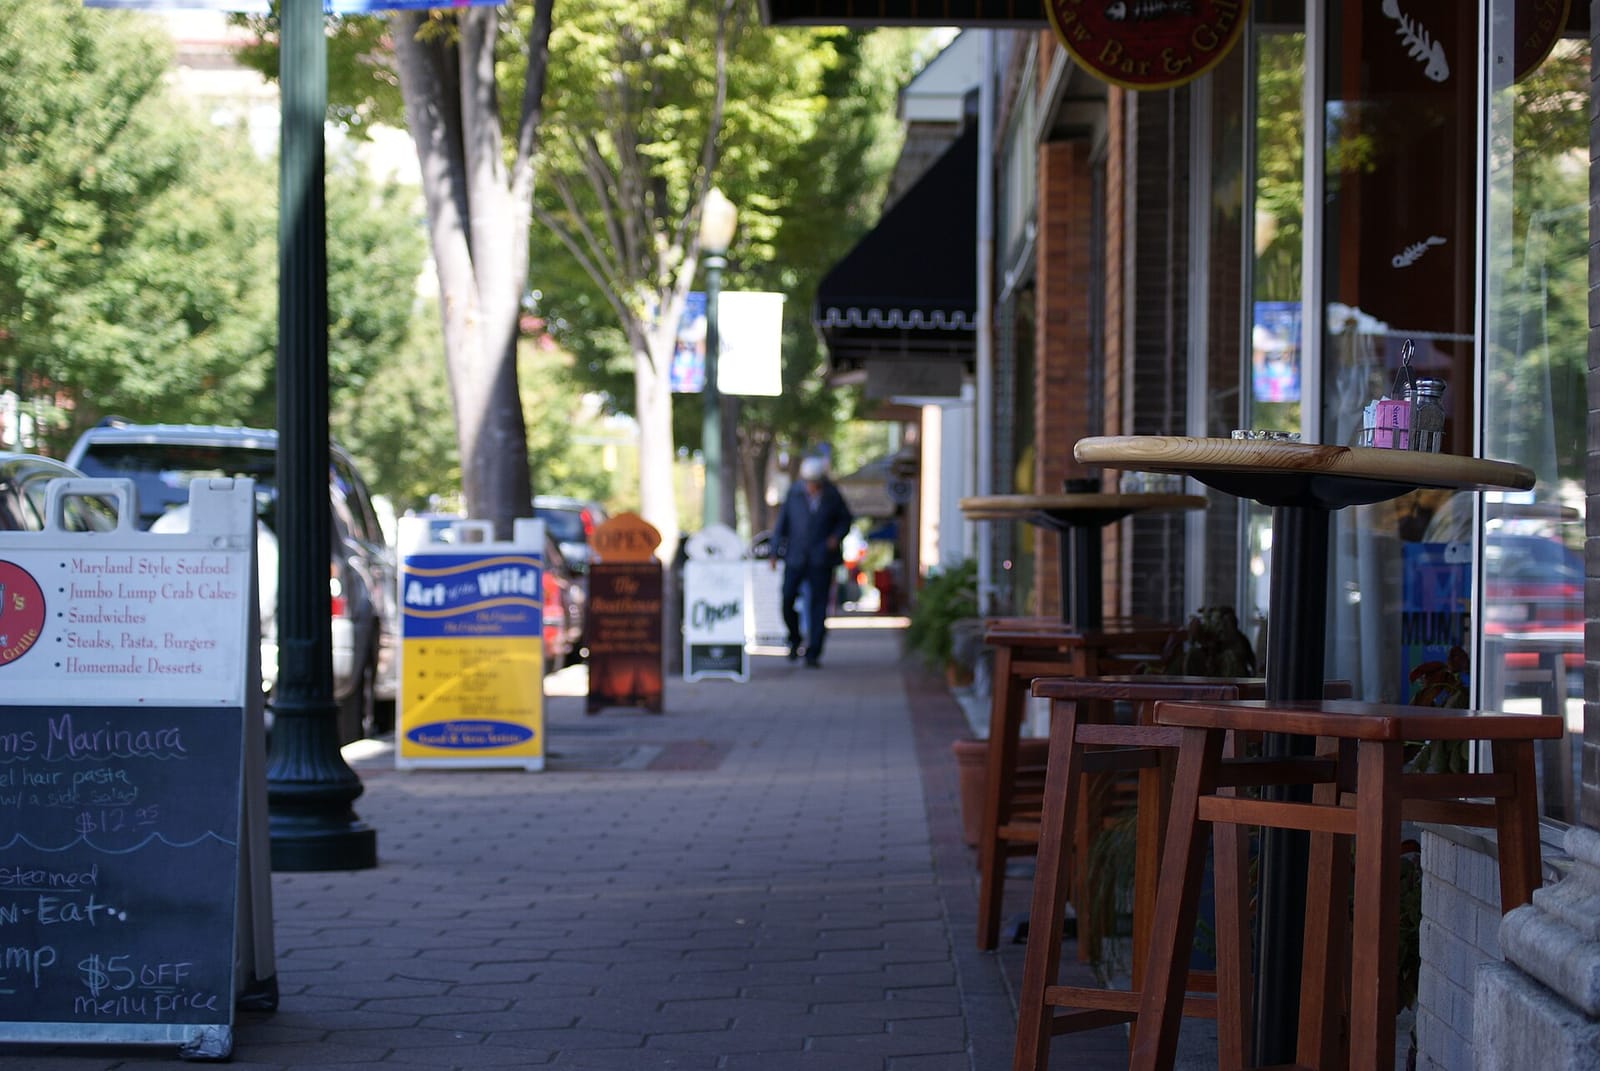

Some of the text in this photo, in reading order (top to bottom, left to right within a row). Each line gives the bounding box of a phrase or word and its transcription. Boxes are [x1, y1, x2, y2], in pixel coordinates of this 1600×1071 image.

[1056, 0, 1091, 41] aw
[1099, 39, 1150, 75] Bar
[1160, 47, 1192, 74] &
[71, 556, 230, 578] Maryland Style Seafood
[69, 581, 237, 604] Jumbo Lump Crab Cakes
[405, 580, 445, 606] Art
[478, 567, 537, 597] Wild
[68, 605, 147, 624] Sandwiches
[691, 600, 740, 634] Open
[2, 628, 37, 660] Grille
[66, 630, 217, 651] Steaks, Pasta, Burgers
[66, 655, 203, 674] Homemade Desserts
[46, 713, 187, 760] Marinara
[22, 768, 63, 785] hair
[72, 768, 132, 792] pasta
[30, 794, 41, 805] a
[90, 786, 139, 802] salad
[0, 946, 56, 988] mp
[78, 953, 193, 997] $5 OFF
[74, 989, 218, 1020] menu price
